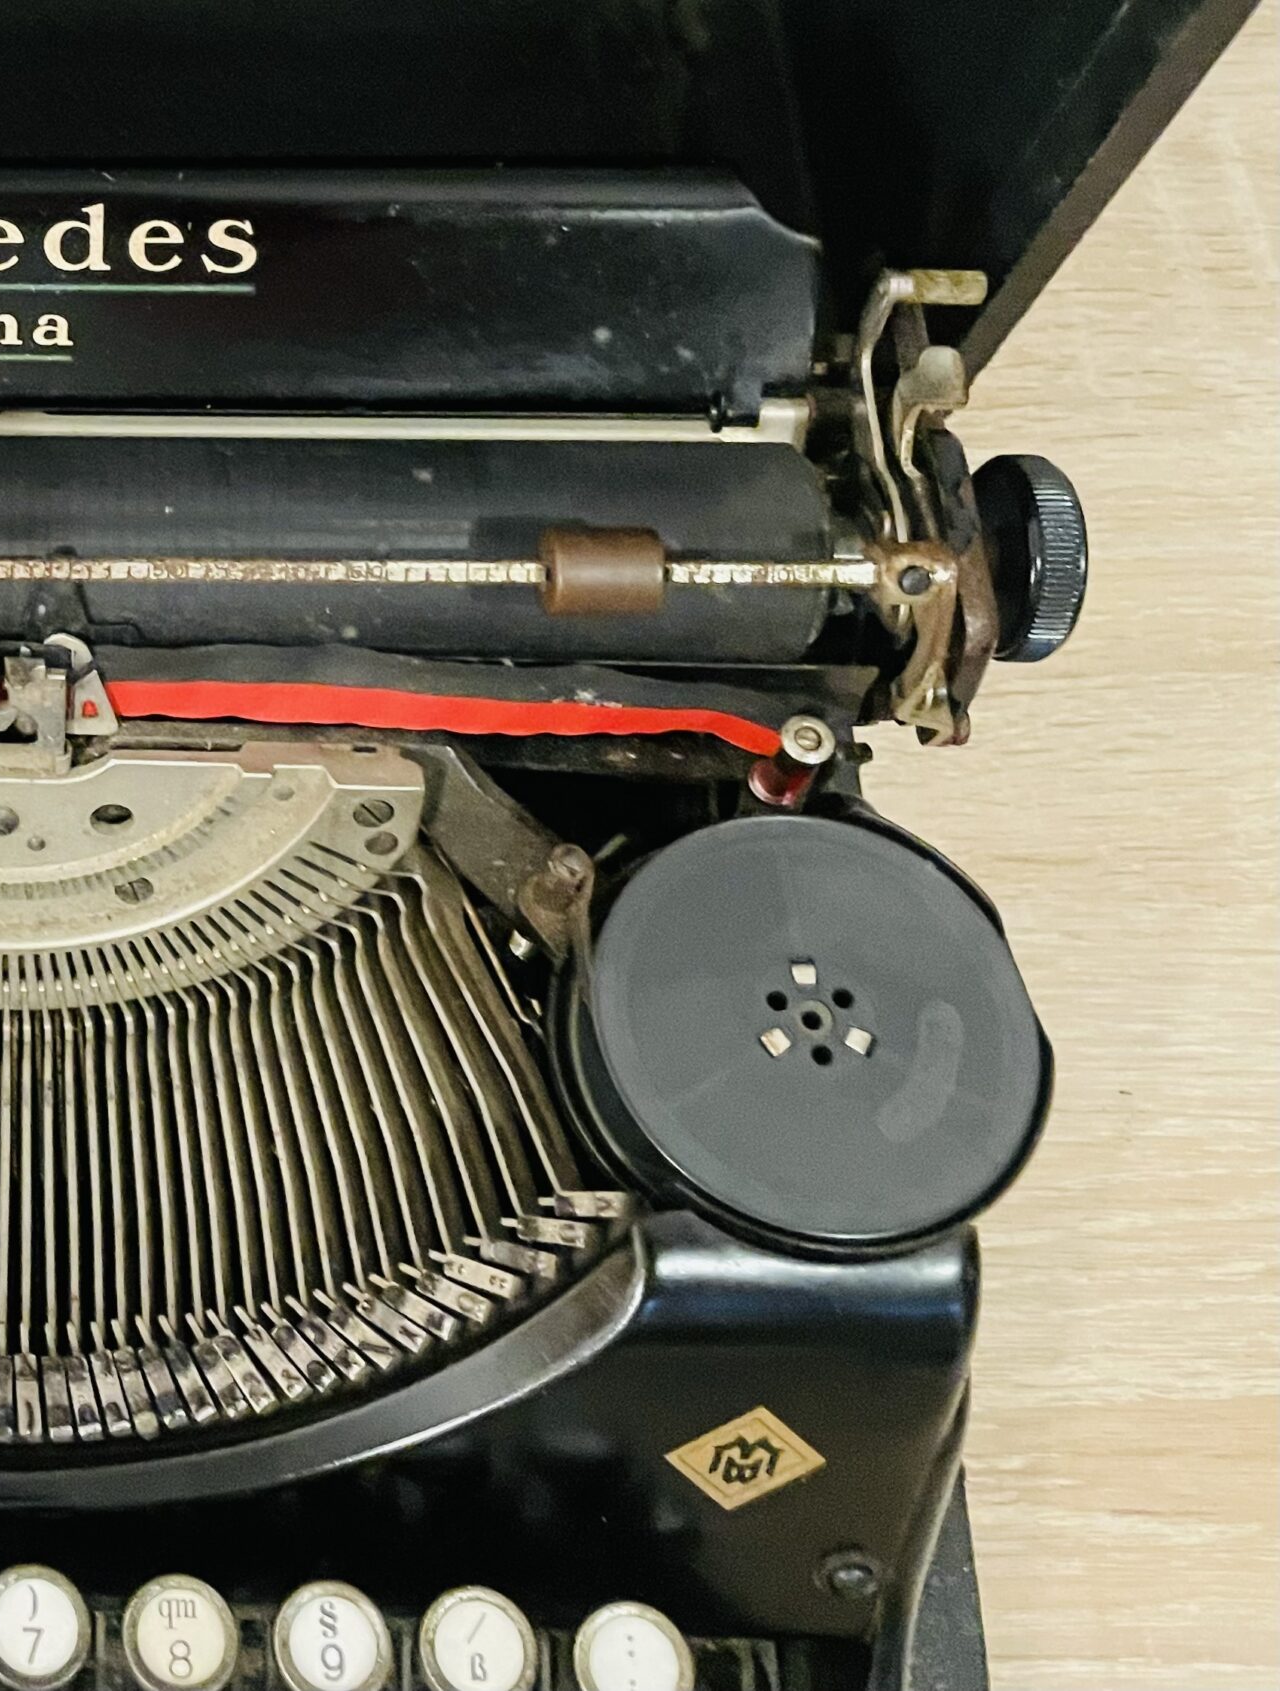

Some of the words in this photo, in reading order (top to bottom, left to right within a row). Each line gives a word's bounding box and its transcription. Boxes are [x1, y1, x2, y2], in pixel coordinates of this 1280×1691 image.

[22, 1626, 45, 1665] 7
[168, 1639, 193, 1679] 8
[320, 1643, 345, 1682] 9
